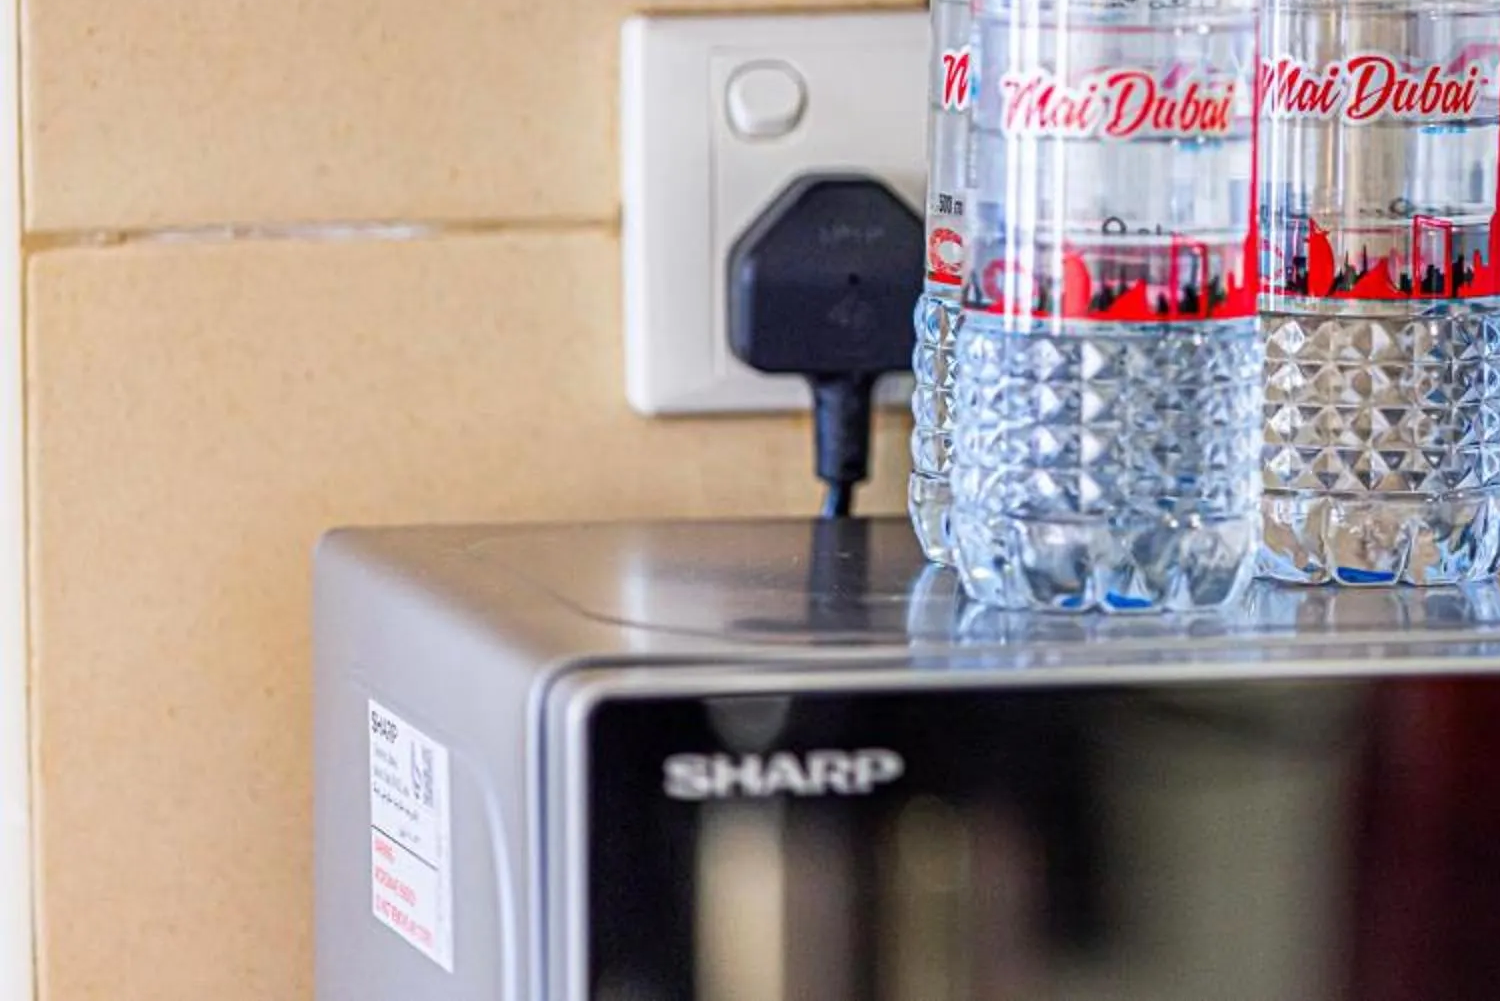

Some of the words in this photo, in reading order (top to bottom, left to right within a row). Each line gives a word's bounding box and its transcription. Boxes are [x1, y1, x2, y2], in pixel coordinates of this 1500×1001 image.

[1004, 77, 1096, 132] Mai
[1106, 71, 1234, 137] Dubai
[1260, 57, 1341, 114] Mai
[1347, 55, 1479, 120] Dubai
[663, 748, 905, 800] SHARP
